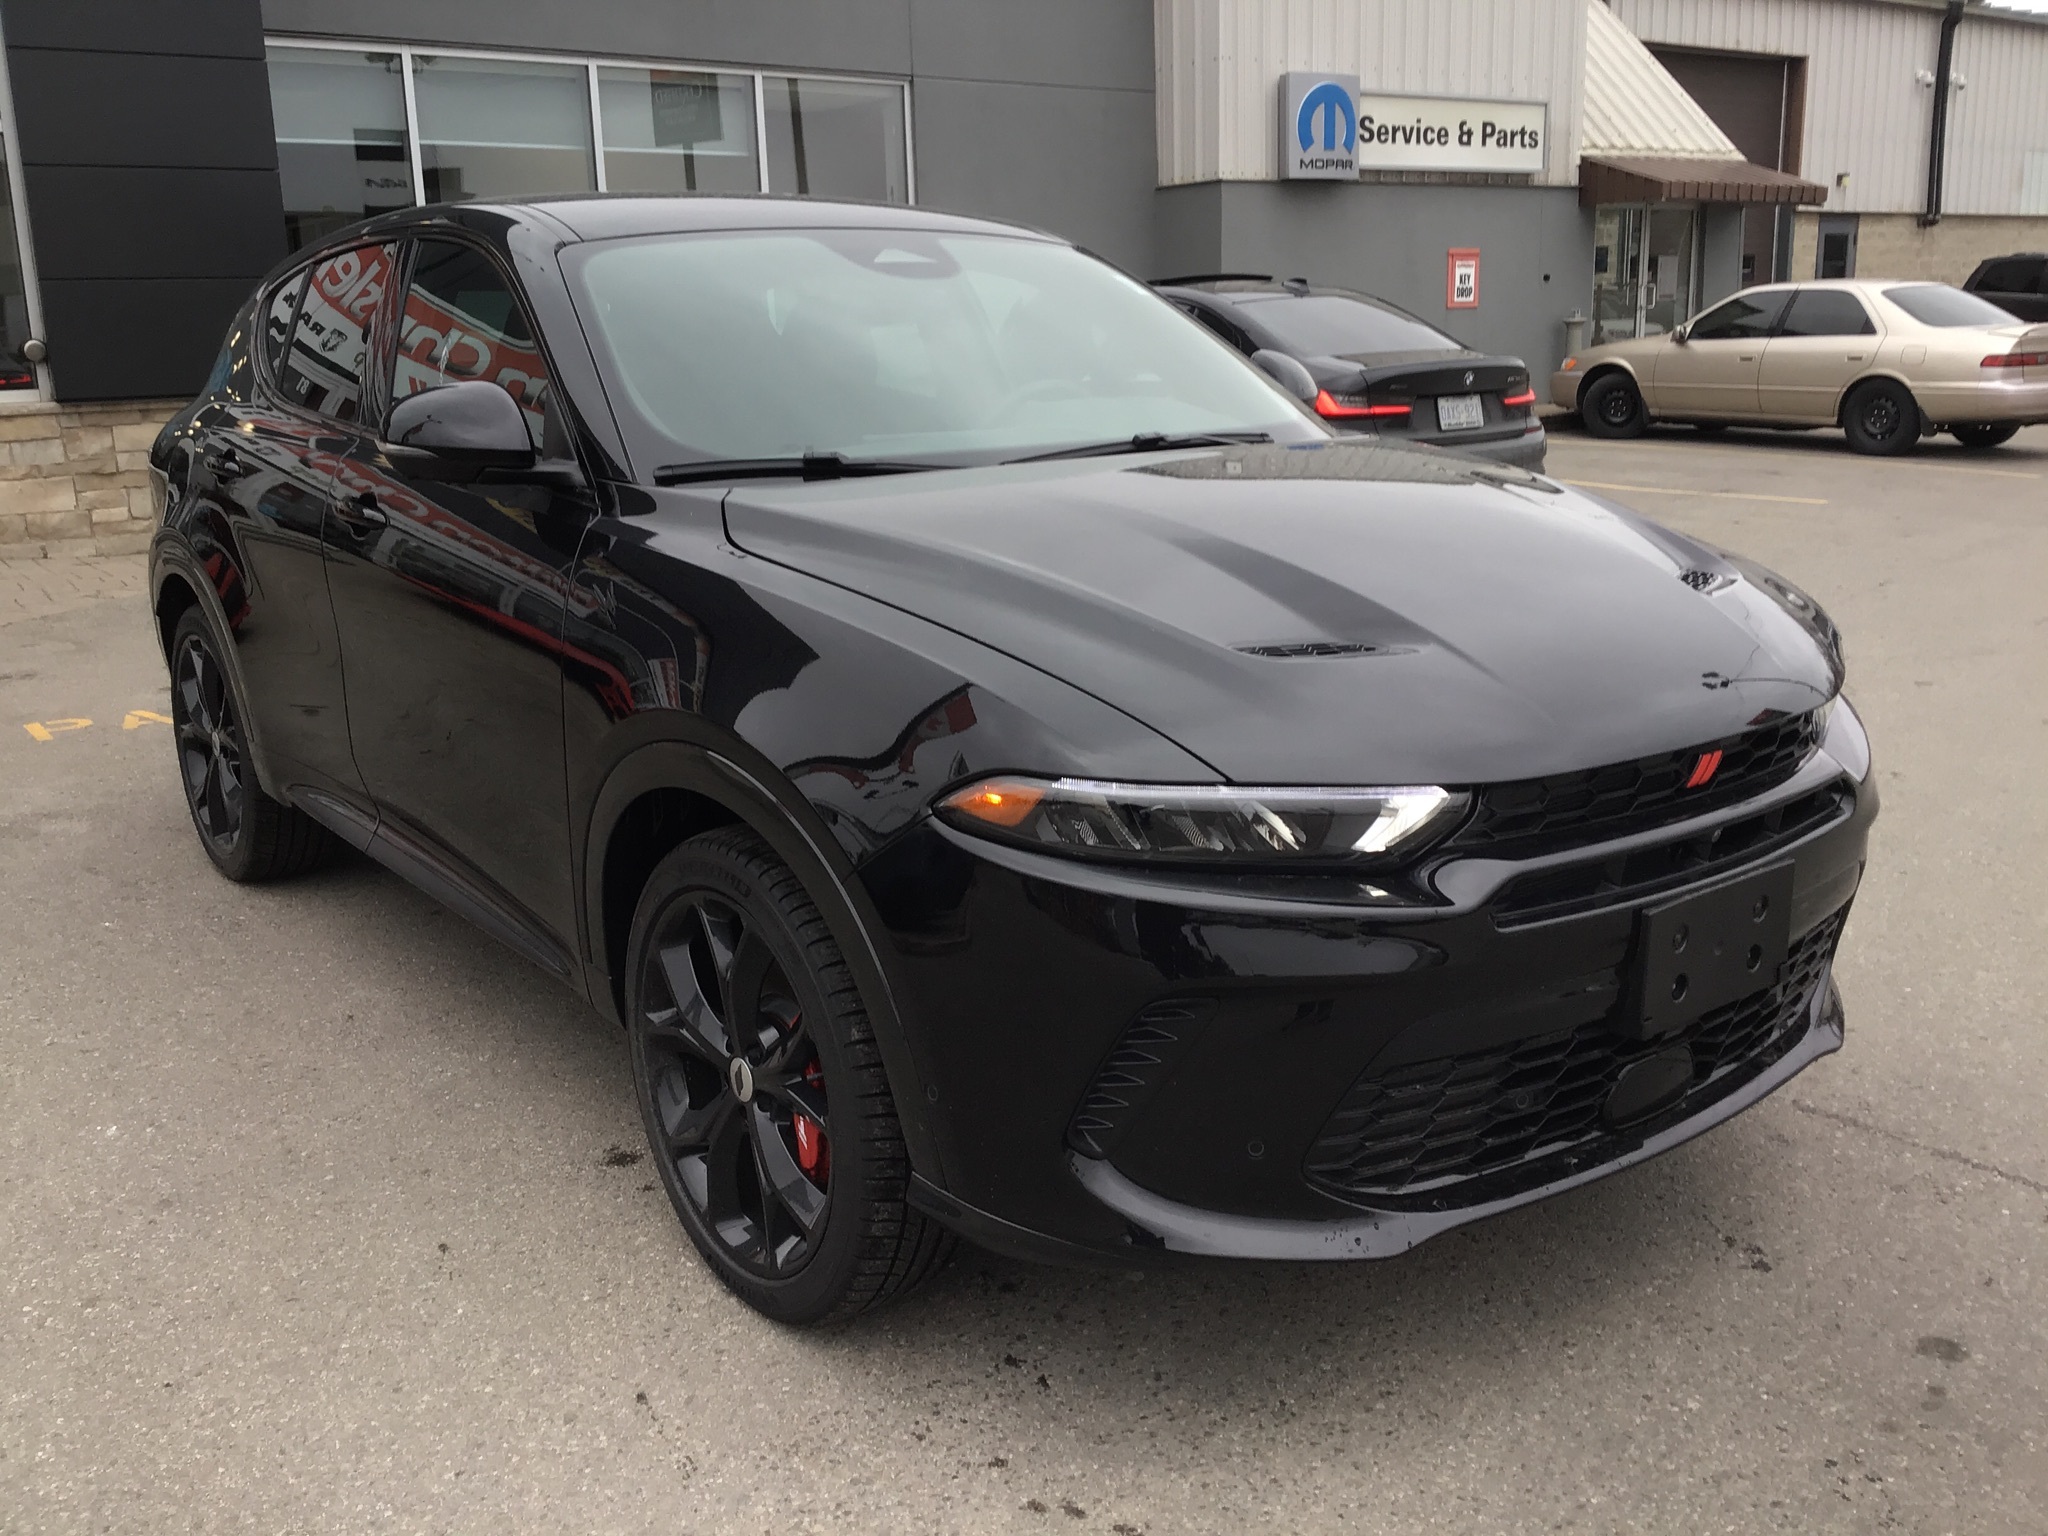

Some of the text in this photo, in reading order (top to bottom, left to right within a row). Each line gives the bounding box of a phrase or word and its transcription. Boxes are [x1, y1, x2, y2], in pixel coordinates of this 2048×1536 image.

[1359, 115, 1539, 149] Service & Parts
[1300, 158, 1354, 170] MOPAR
[1459, 273, 1471, 285] KEY
[1456, 286, 1473, 299] DROP
